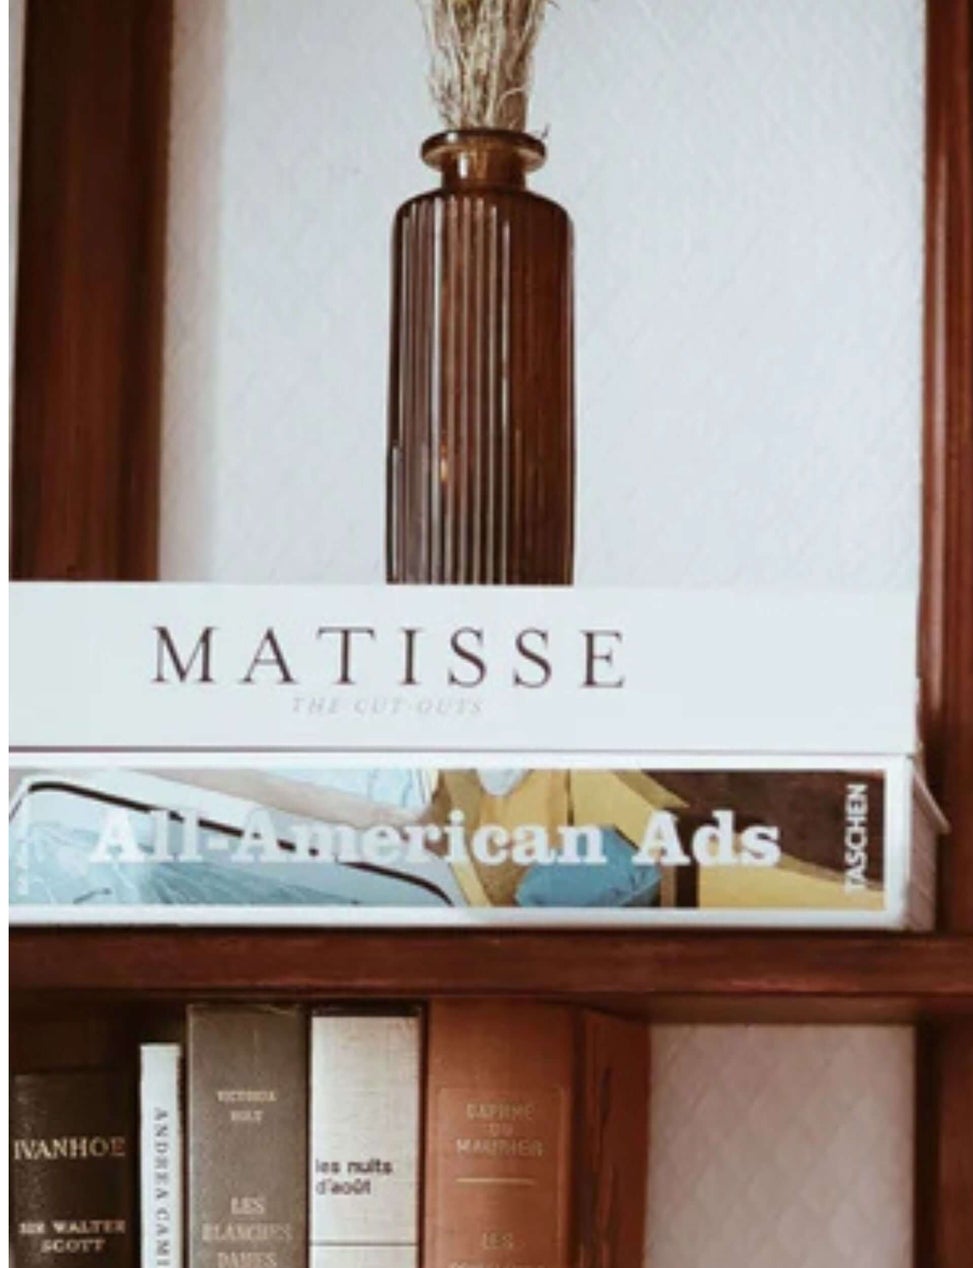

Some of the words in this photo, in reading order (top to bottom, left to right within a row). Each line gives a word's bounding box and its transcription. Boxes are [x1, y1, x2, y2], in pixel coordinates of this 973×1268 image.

[151, 625, 626, 688] MATISSE
[292, 697, 341, 715] THE
[88, 808, 606, 867] All-American
[631, 808, 783, 868] Ads
[845, 784, 868, 896] TASCHEN
[14, 1136, 125, 1160] IVANHOE
[154, 1107, 169, 1200] ANDREA
[315, 1159, 341, 1174] les
[347, 1158, 393, 1174] nuits
[315, 1178, 371, 1195] d'août
[231, 1197, 265, 1215] LES
[19, 1221, 45, 1235] SIR
[53, 1219, 126, 1235] WALTER
[41, 1239, 106, 1254] SCOTT
